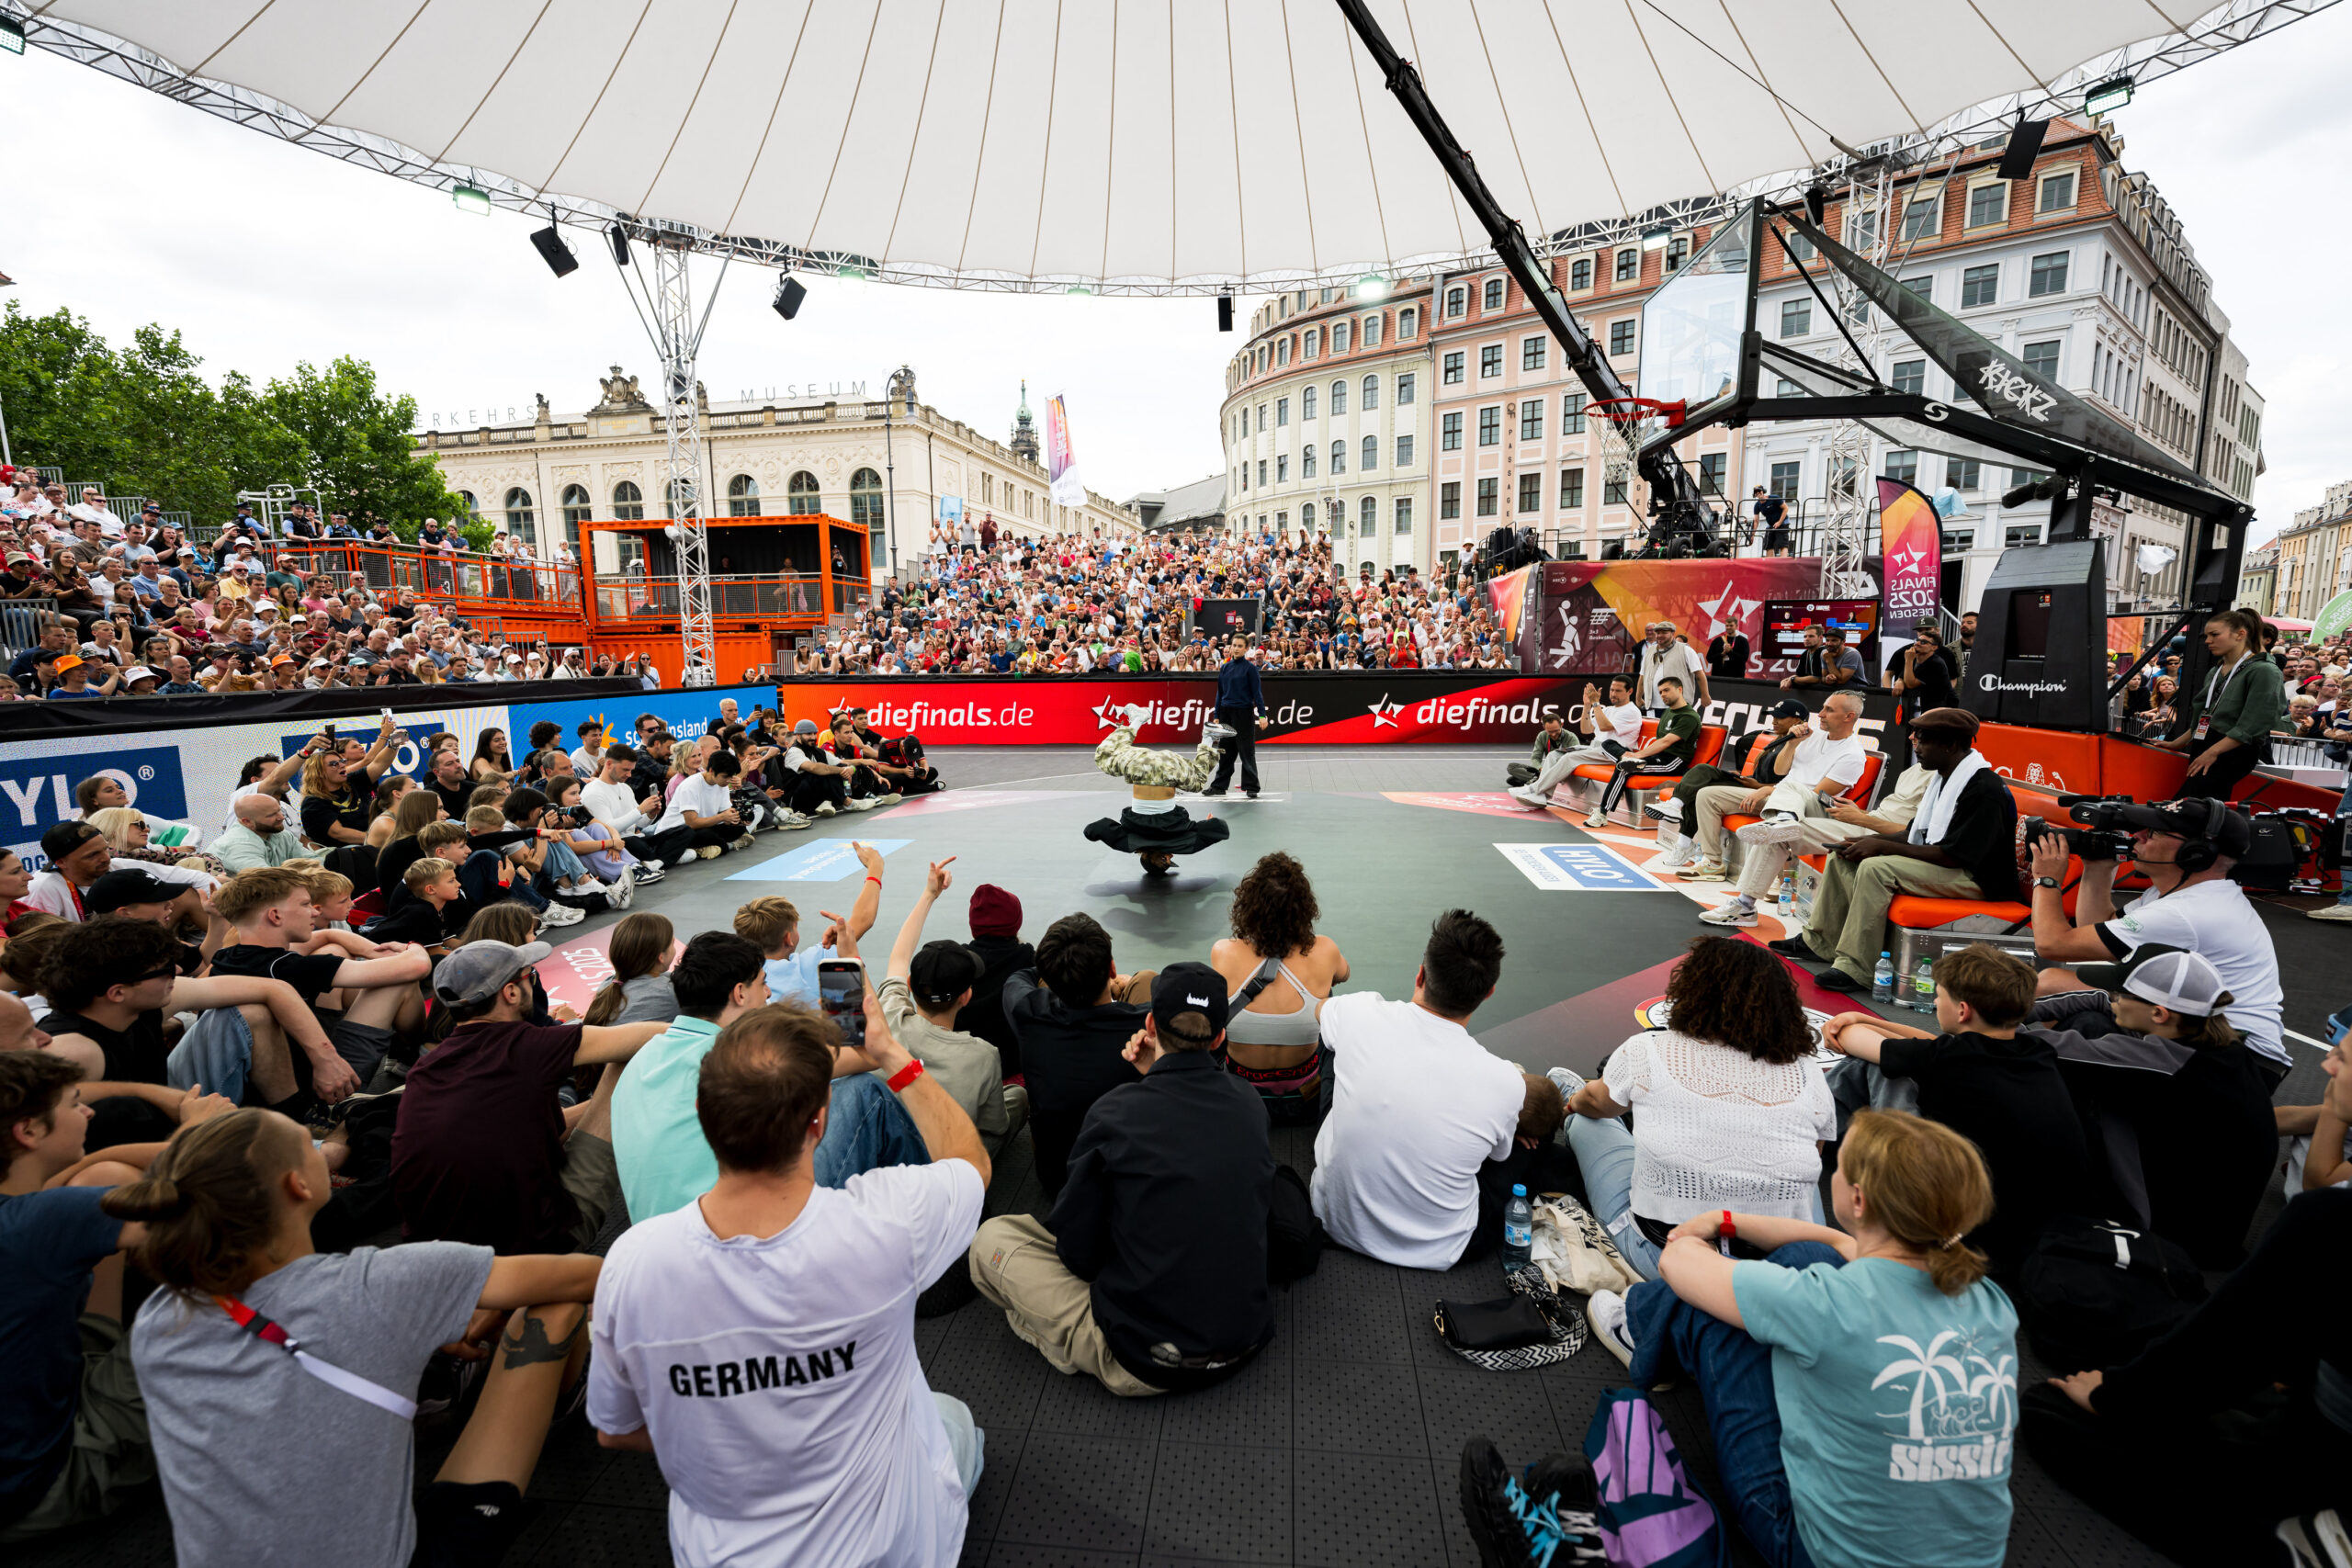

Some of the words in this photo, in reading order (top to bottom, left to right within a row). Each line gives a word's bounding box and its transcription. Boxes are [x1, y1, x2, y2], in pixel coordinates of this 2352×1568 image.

[415, 406, 536, 428] ERKEHRS
[741, 380, 866, 404] MUSEUM
[1978, 358, 2059, 423] KICKZ
[1506, 429, 1514, 517] PASSAGE
[1979, 673, 2067, 699] Champion
[867, 701, 1035, 733] diefinals.de
[669, 1340, 857, 1398] GERMANY
